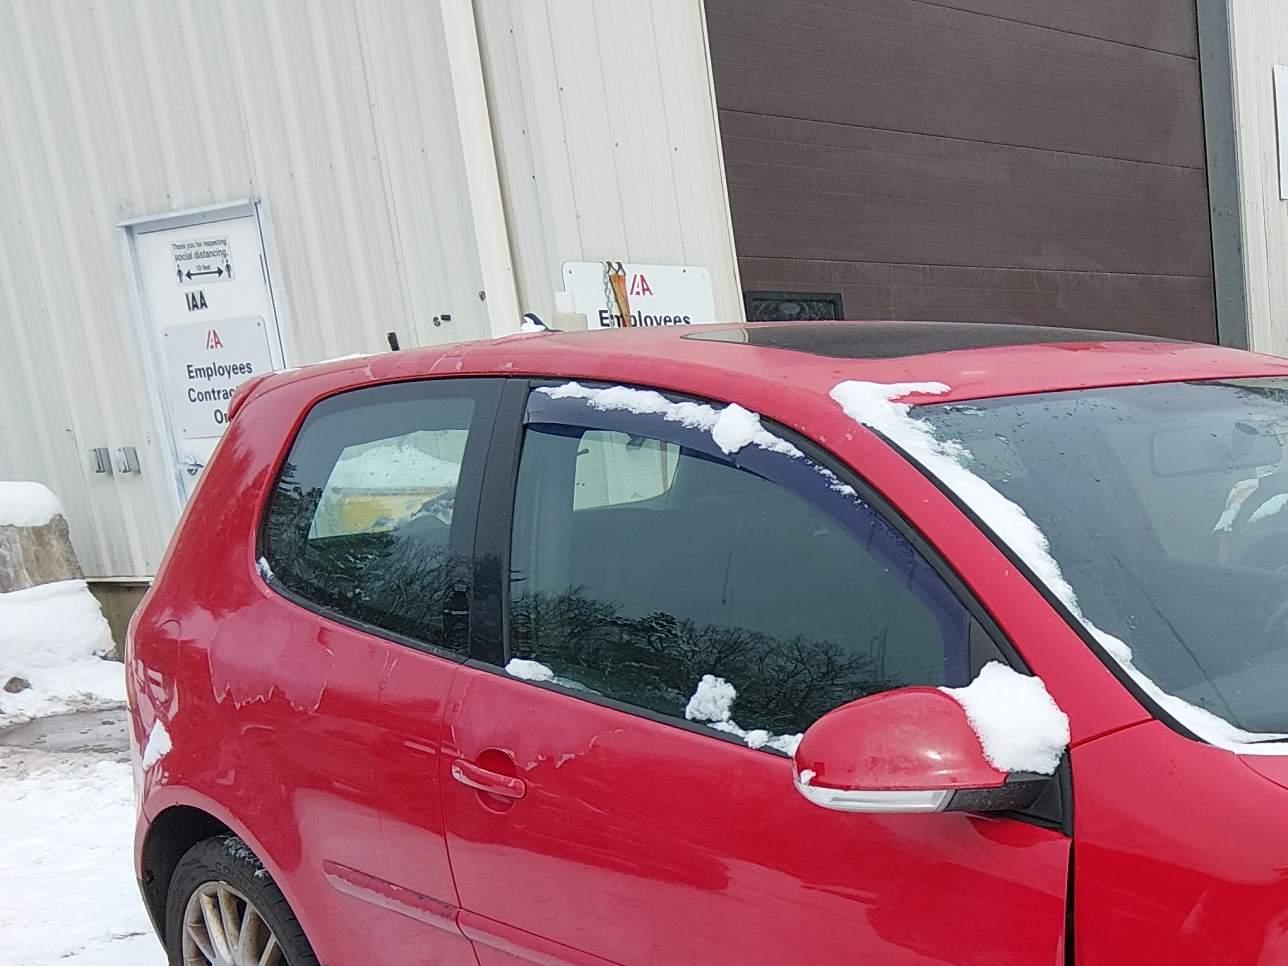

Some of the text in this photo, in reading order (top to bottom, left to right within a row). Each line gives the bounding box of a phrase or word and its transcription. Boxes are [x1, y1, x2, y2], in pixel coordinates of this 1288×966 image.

[175, 251, 193, 261] social
[185, 290, 208, 312] IAA
[186, 362, 252, 381] Employees
[188, 386, 235, 403] Contrac
